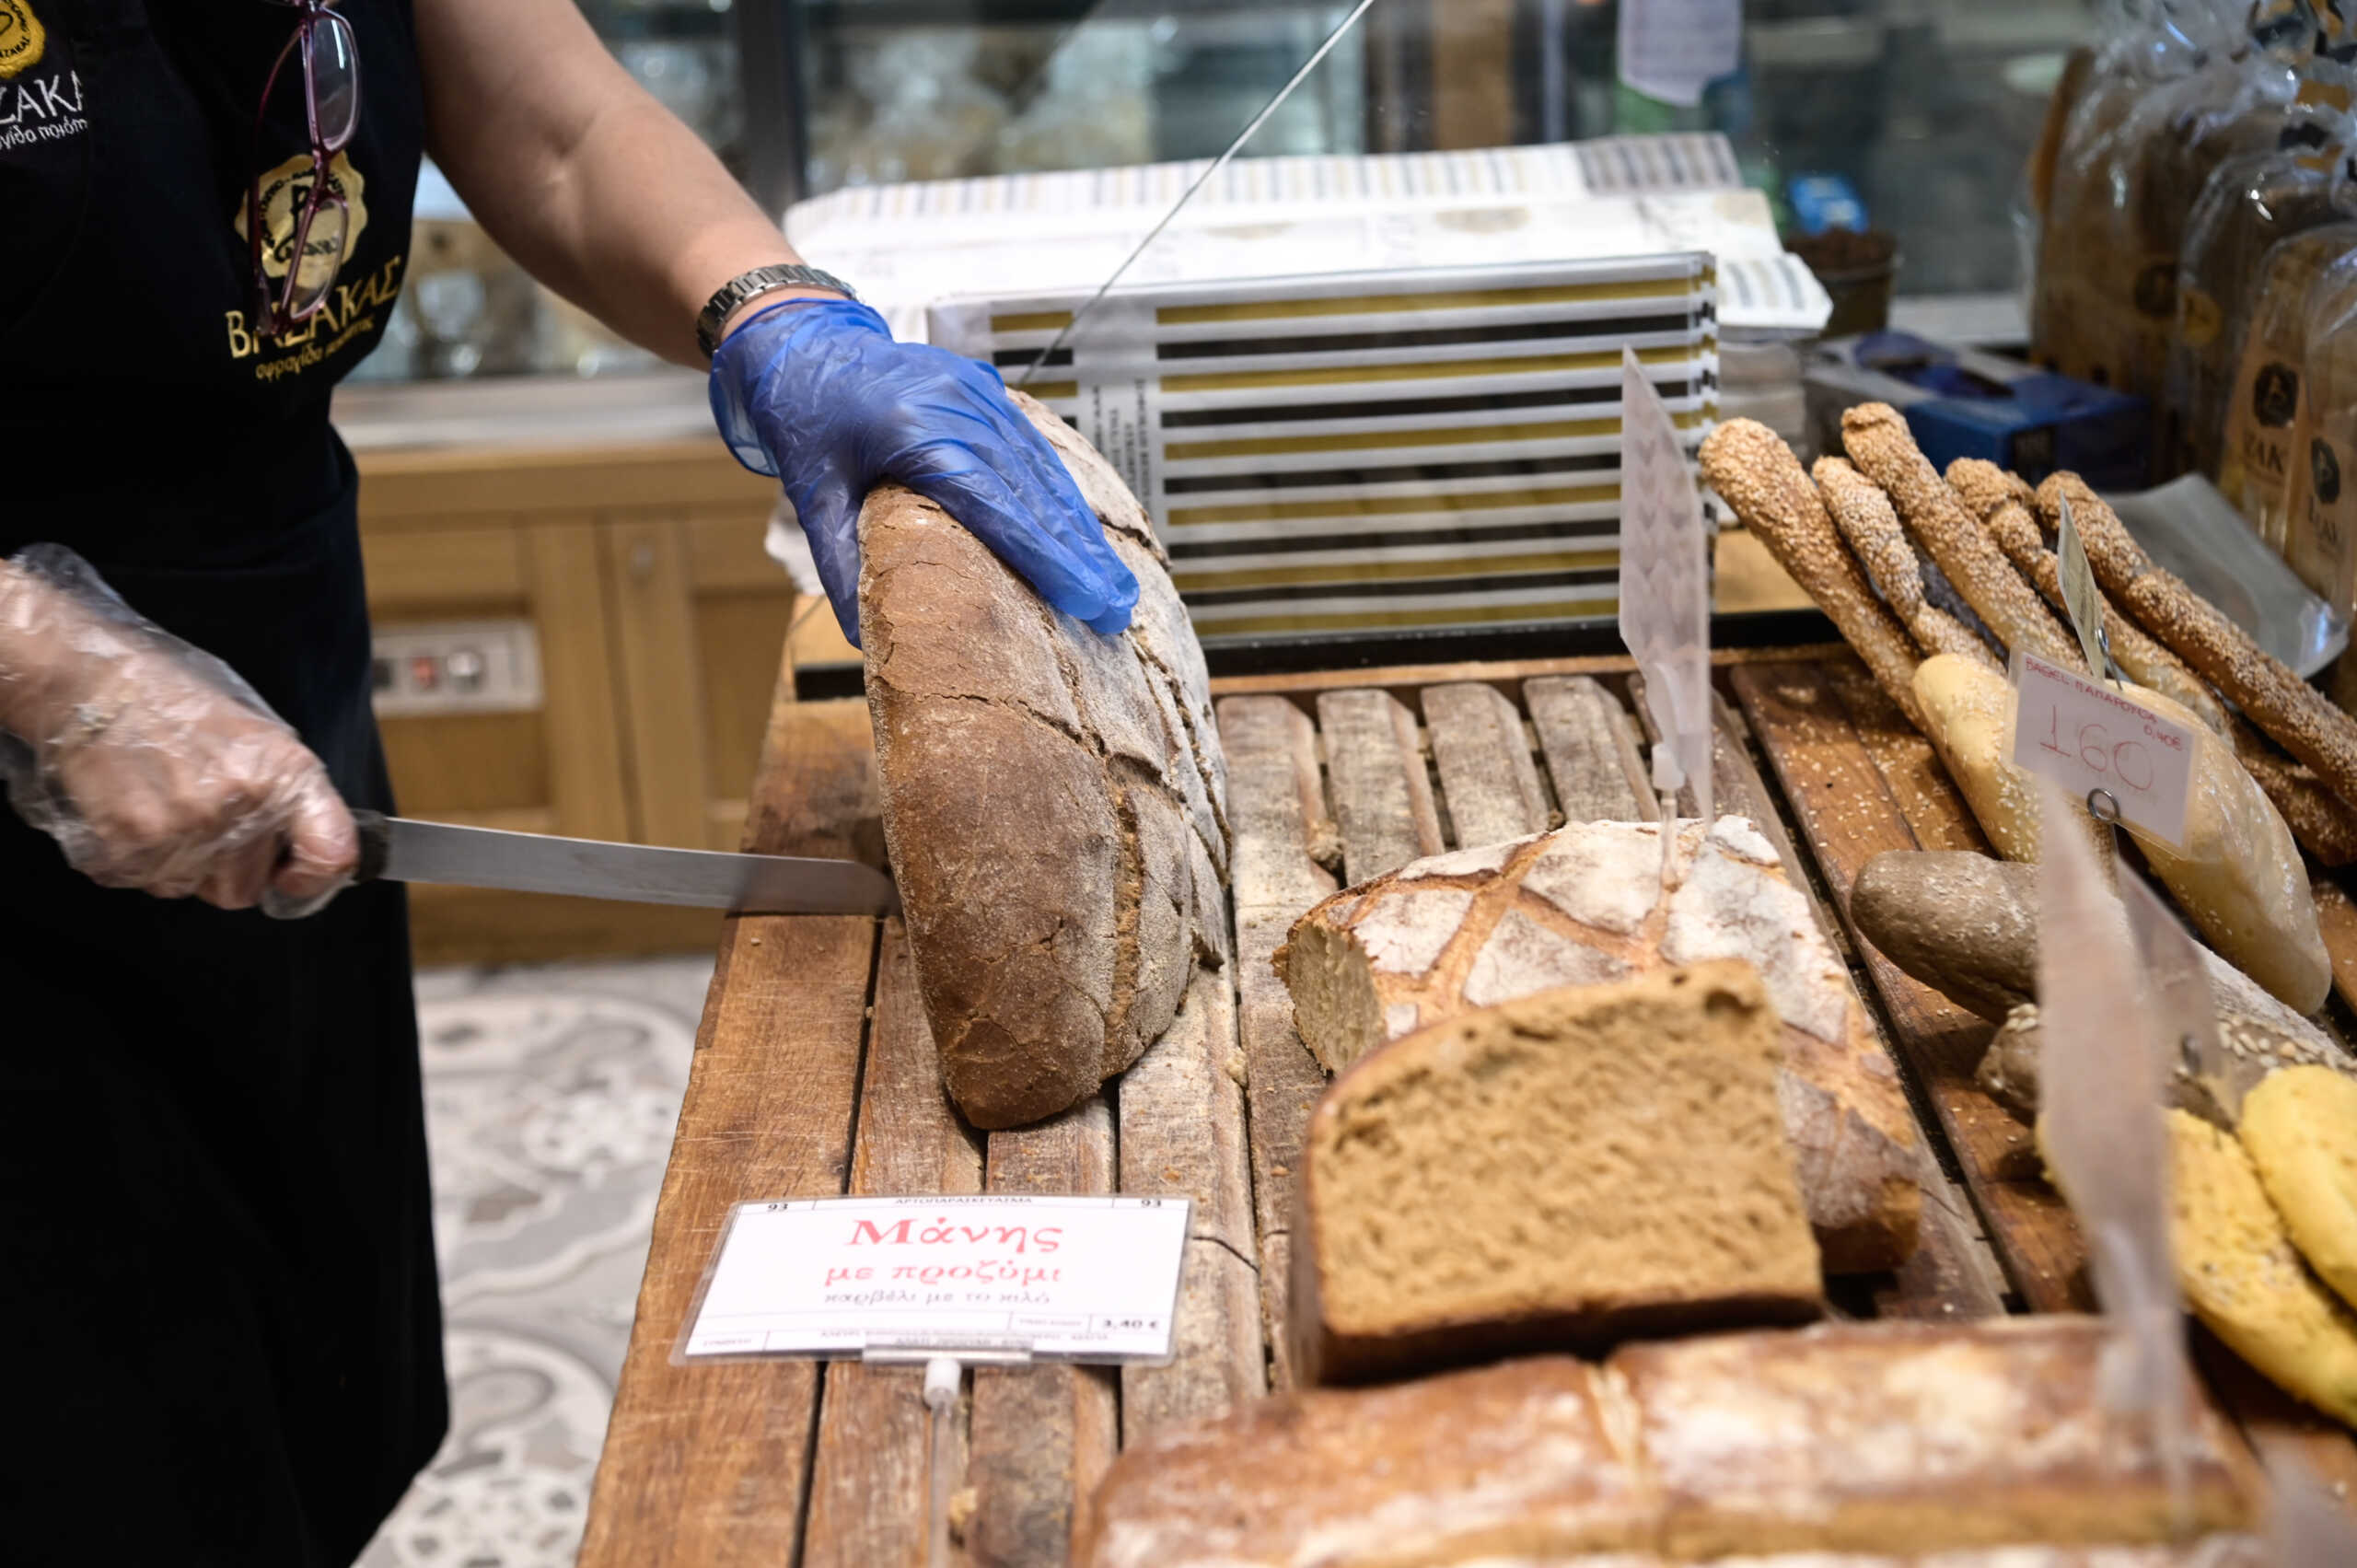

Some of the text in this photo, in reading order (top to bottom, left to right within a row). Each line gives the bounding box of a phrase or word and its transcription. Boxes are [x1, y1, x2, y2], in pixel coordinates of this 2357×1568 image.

[226, 254, 401, 359] ΒΖΑΚΑΣ
[843, 1216, 1063, 1254] Μάνης
[824, 1260, 1062, 1287] με προζύμι
